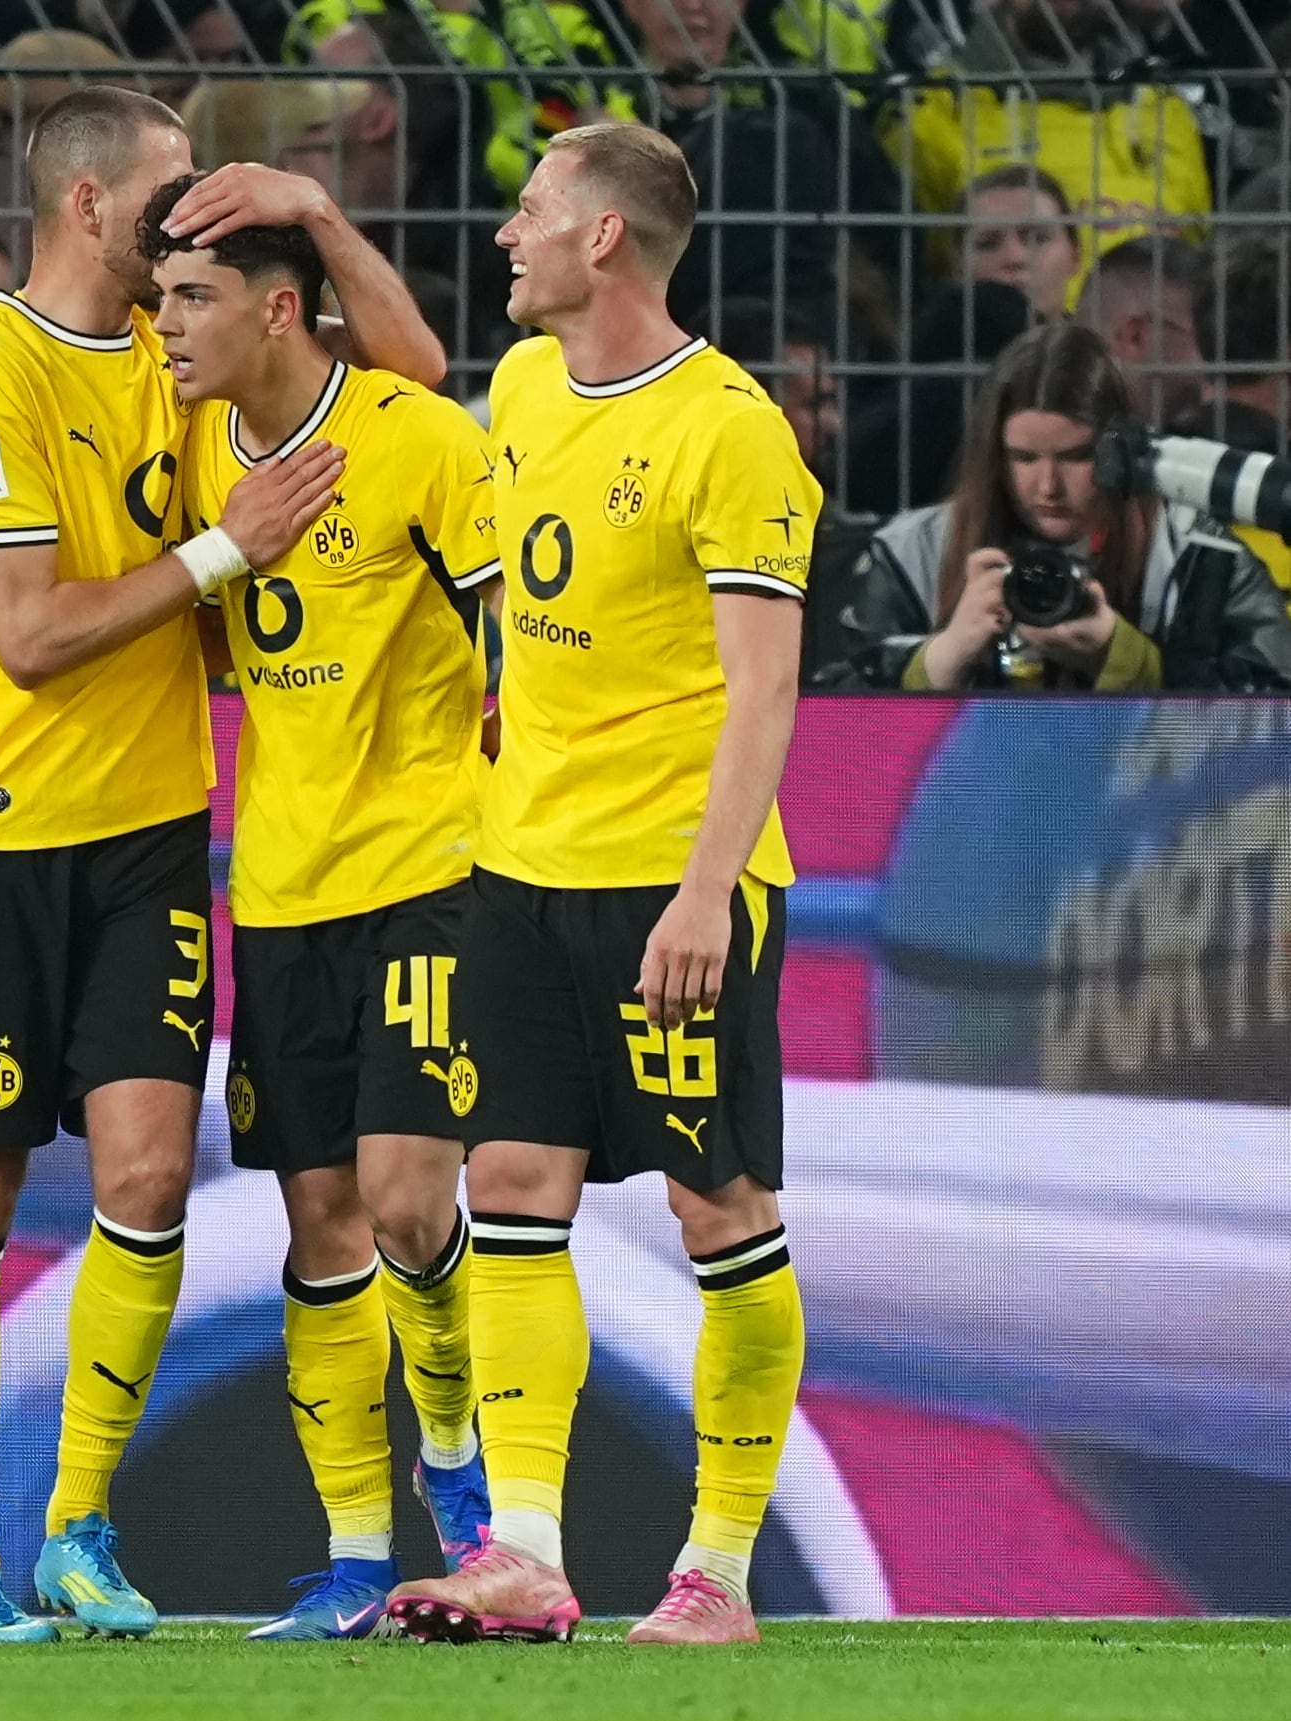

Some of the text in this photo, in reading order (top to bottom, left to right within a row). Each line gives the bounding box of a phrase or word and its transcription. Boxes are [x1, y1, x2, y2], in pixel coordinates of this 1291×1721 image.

[608, 478, 643, 513] BVB
[315, 518, 355, 555] BVB
[330, 551, 345, 564] 09
[754, 552, 812, 573] Polest
[512, 609, 592, 650] odafone
[169, 908, 207, 999] 3
[619, 1003, 717, 1097] 26
[231, 1081, 251, 1115] BVB
[452, 1063, 473, 1100] BVB
